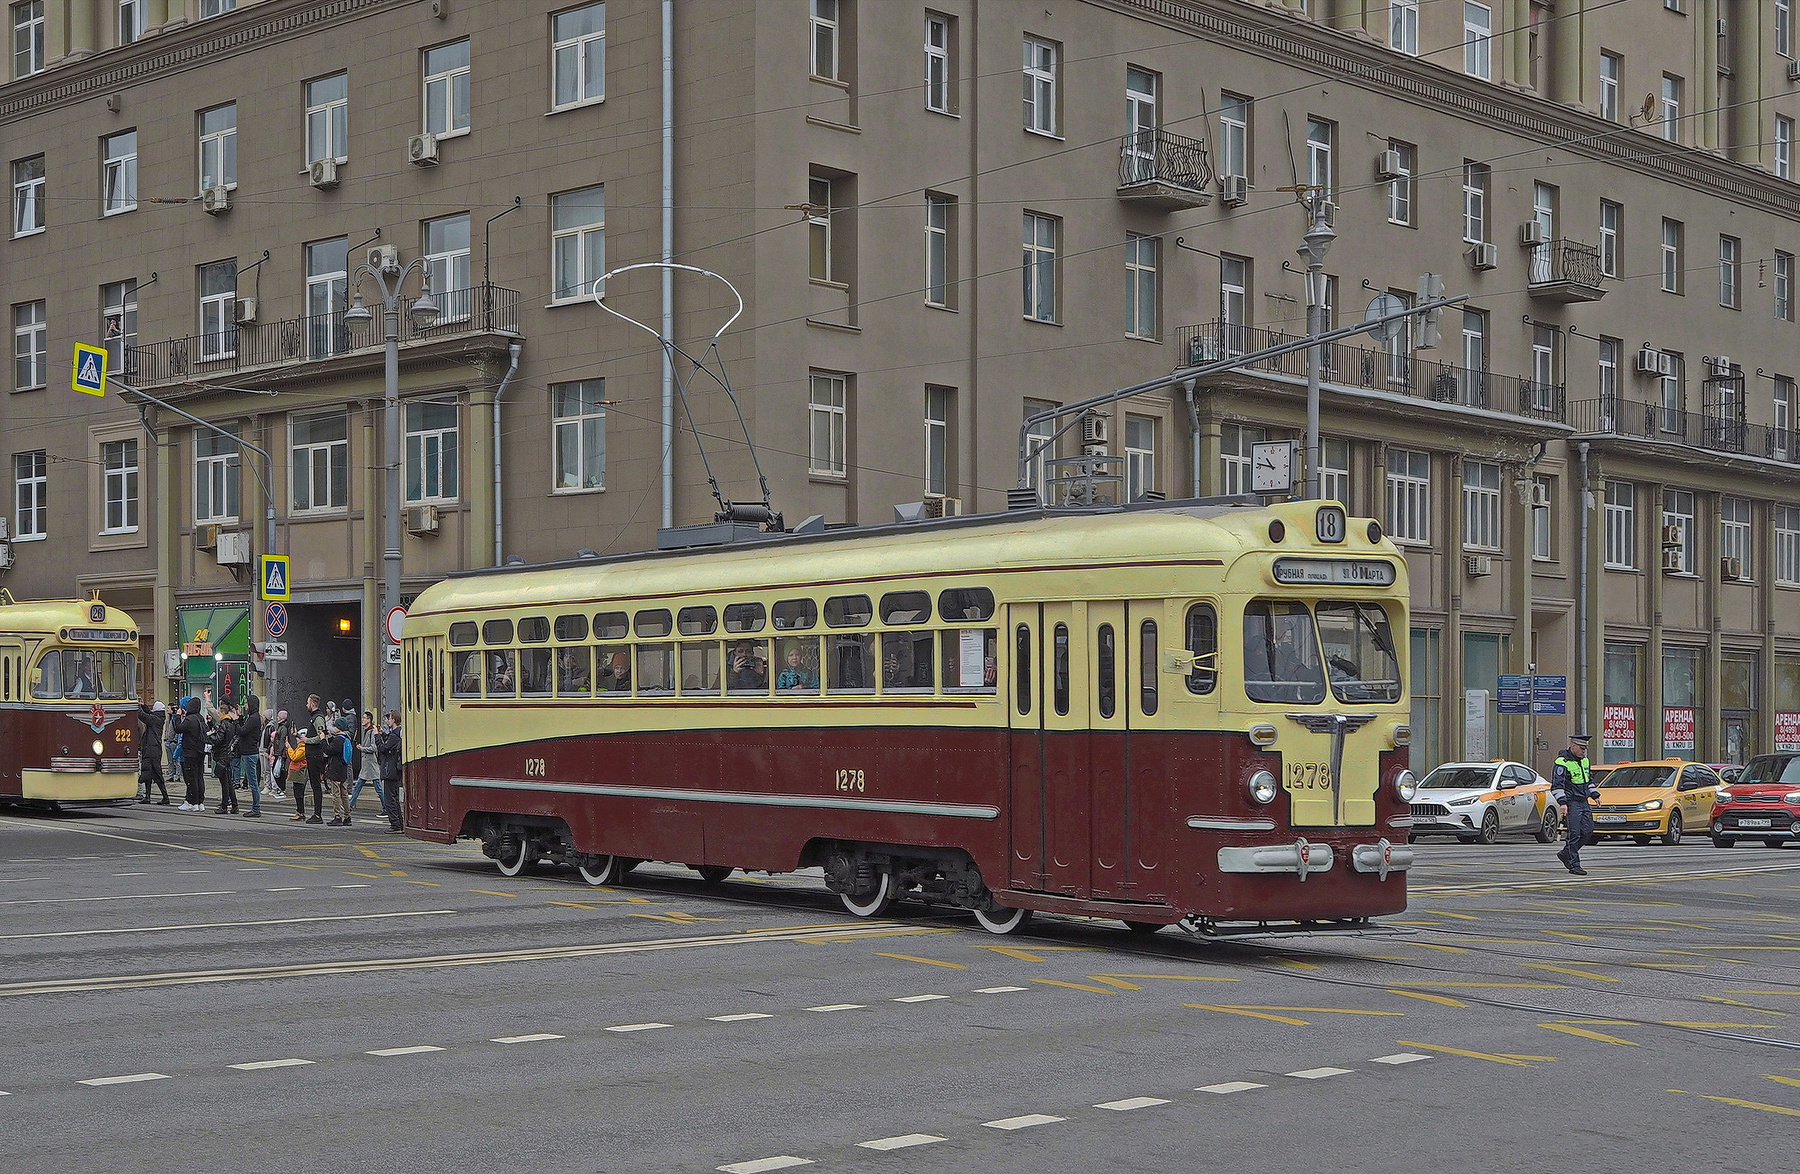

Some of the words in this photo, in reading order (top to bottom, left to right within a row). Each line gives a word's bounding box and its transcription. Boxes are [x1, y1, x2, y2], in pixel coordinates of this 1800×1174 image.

[1319, 513, 1336, 537] 18
[1351, 561, 1358, 579] 8
[93, 608, 102, 619] 26
[224, 663, 232, 696] ТАБ
[1604, 707, 1634, 720] АРЕНДА
[1665, 710, 1694, 723] АРЕНДА
[115, 729, 131, 742] 222
[1604, 730, 1634, 738] 490-0-500
[1665, 732, 1694, 740] 490-0-500
[525, 758, 546, 777] 1278
[835, 769, 865, 793] 1278
[1285, 762, 1330, 790] 1278
